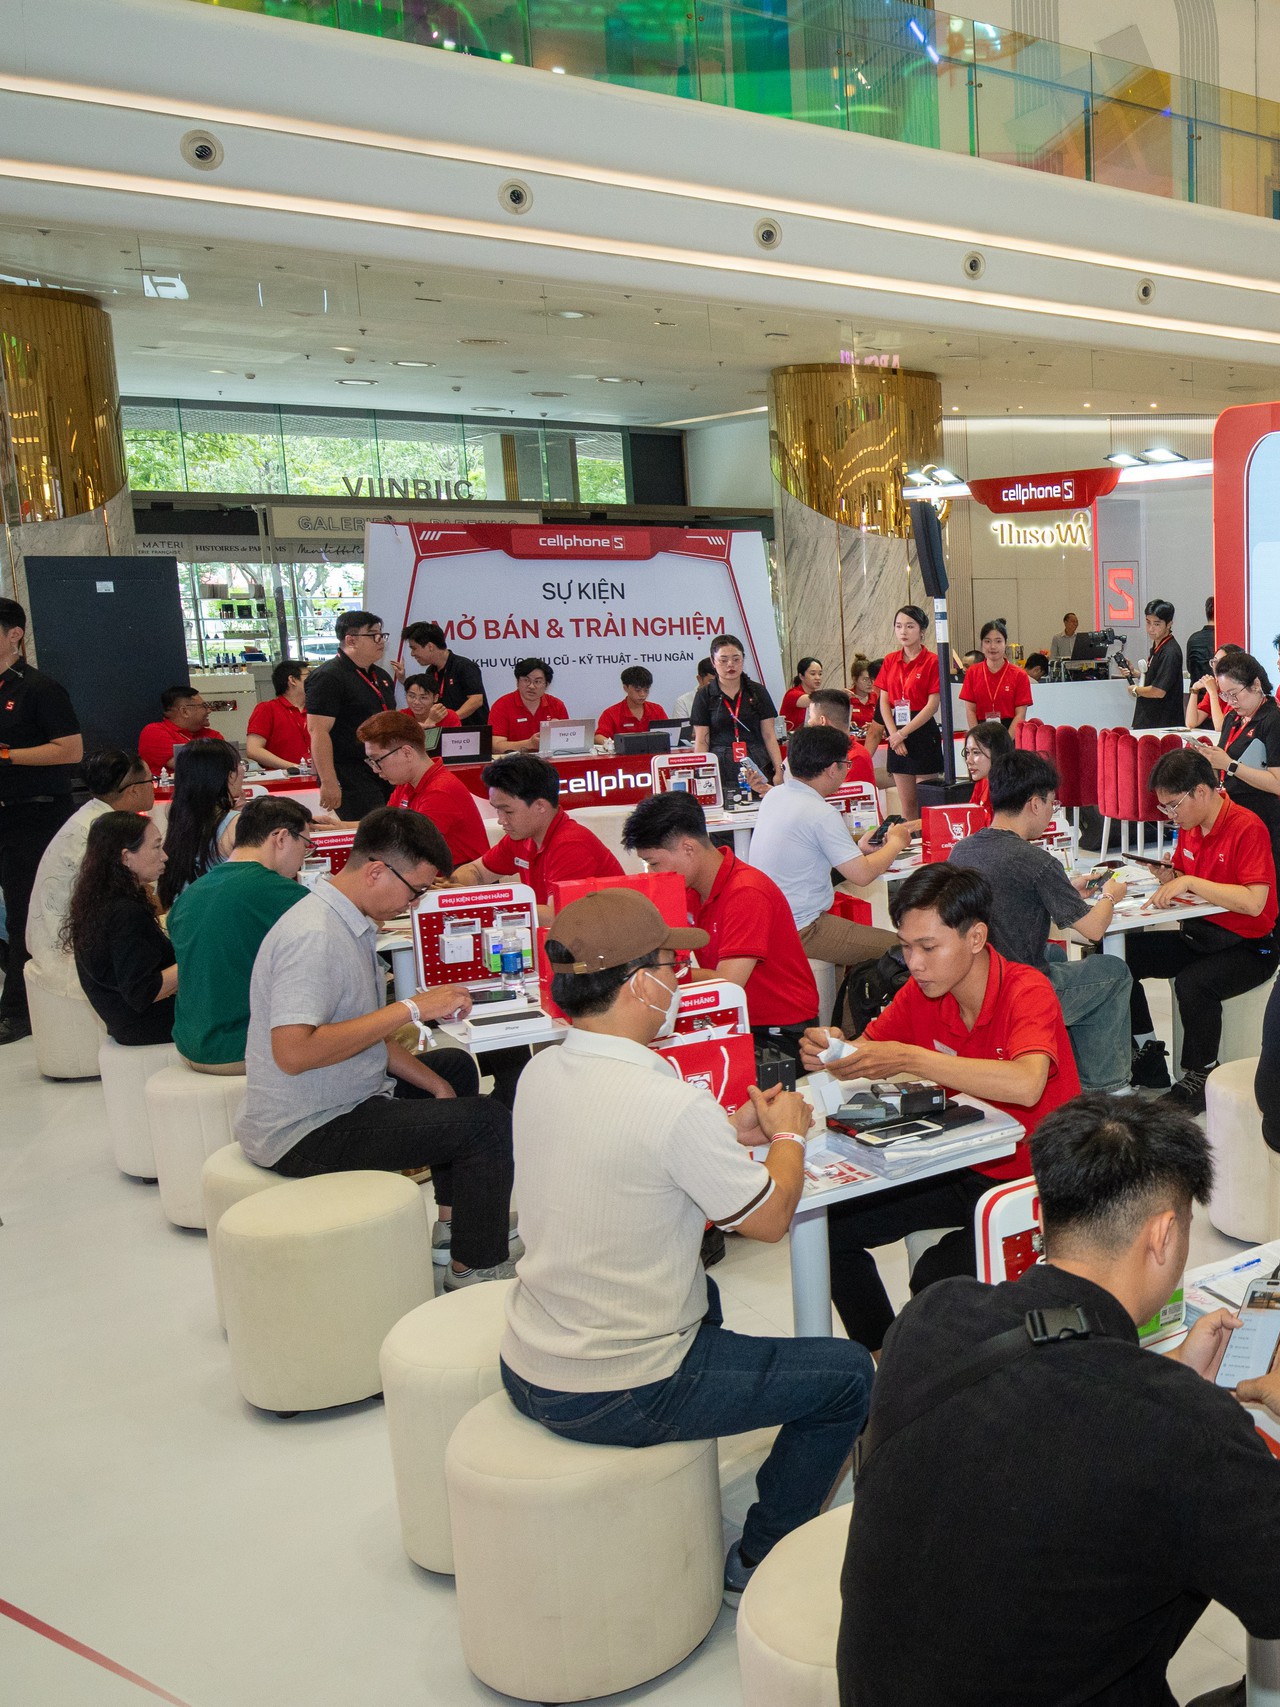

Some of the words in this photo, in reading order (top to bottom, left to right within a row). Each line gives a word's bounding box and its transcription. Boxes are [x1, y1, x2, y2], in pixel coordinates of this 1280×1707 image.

[143, 540, 184, 550] MATERI
[195, 545, 239, 553] HISTOIRES
[542, 580, 573, 605] SỰ
[578, 578, 626, 604] KIỆN
[432, 613, 477, 641] MỞ
[484, 612, 541, 639] BÁN
[546, 618, 564, 639] &
[569, 611, 627, 638] TRẢI
[633, 611, 726, 641] NGHIỆM
[471, 658, 497, 669] KHU
[554, 653, 569, 666] CŨ
[579, 653, 594, 667] KỸ
[596, 651, 631, 666] THUẬT
[641, 653, 662, 663] THU
[664, 650, 694, 662] NGÂN
[559, 769, 652, 799] cellpho
